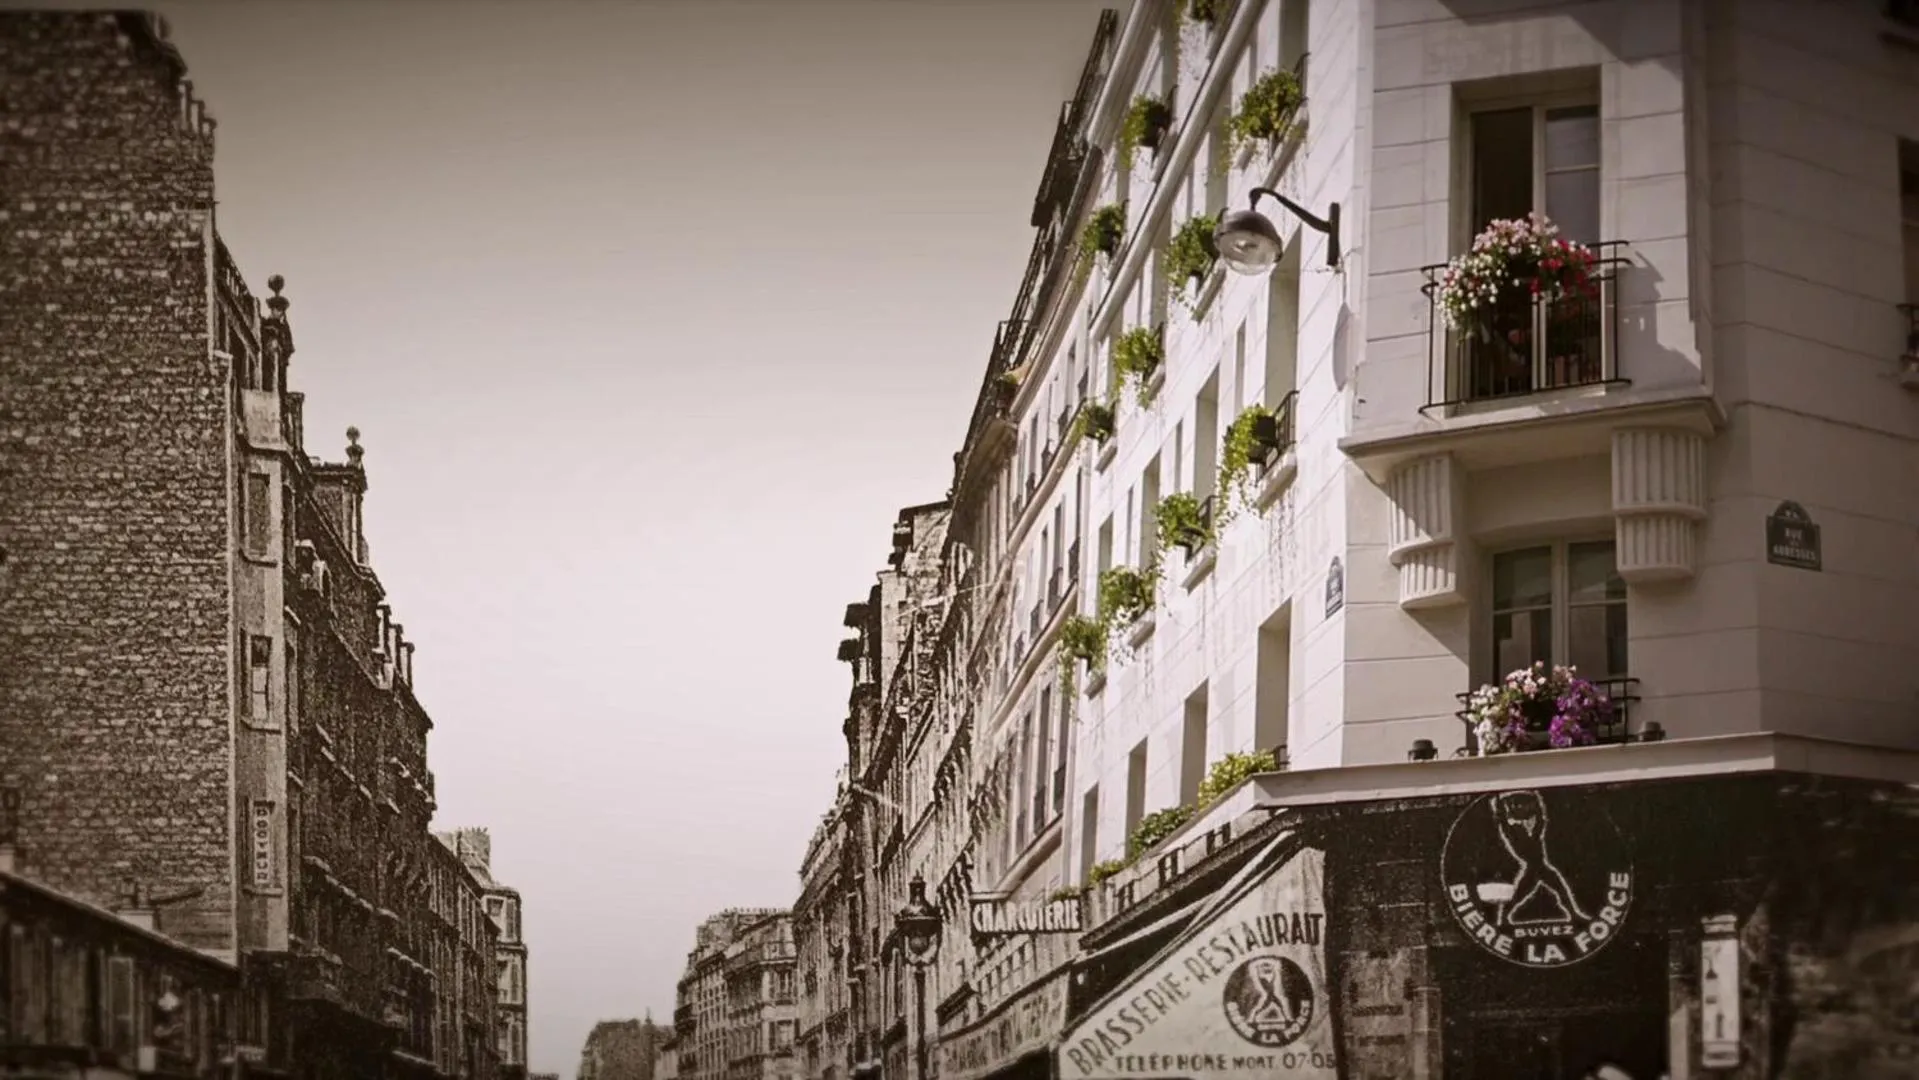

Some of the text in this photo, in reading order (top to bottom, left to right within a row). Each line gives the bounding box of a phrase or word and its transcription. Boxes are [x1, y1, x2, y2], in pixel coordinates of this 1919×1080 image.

[1514, 925, 1575, 938] BUVEZ
[1527, 944, 1566, 963] LA
[1574, 872, 1629, 953] FORCE
